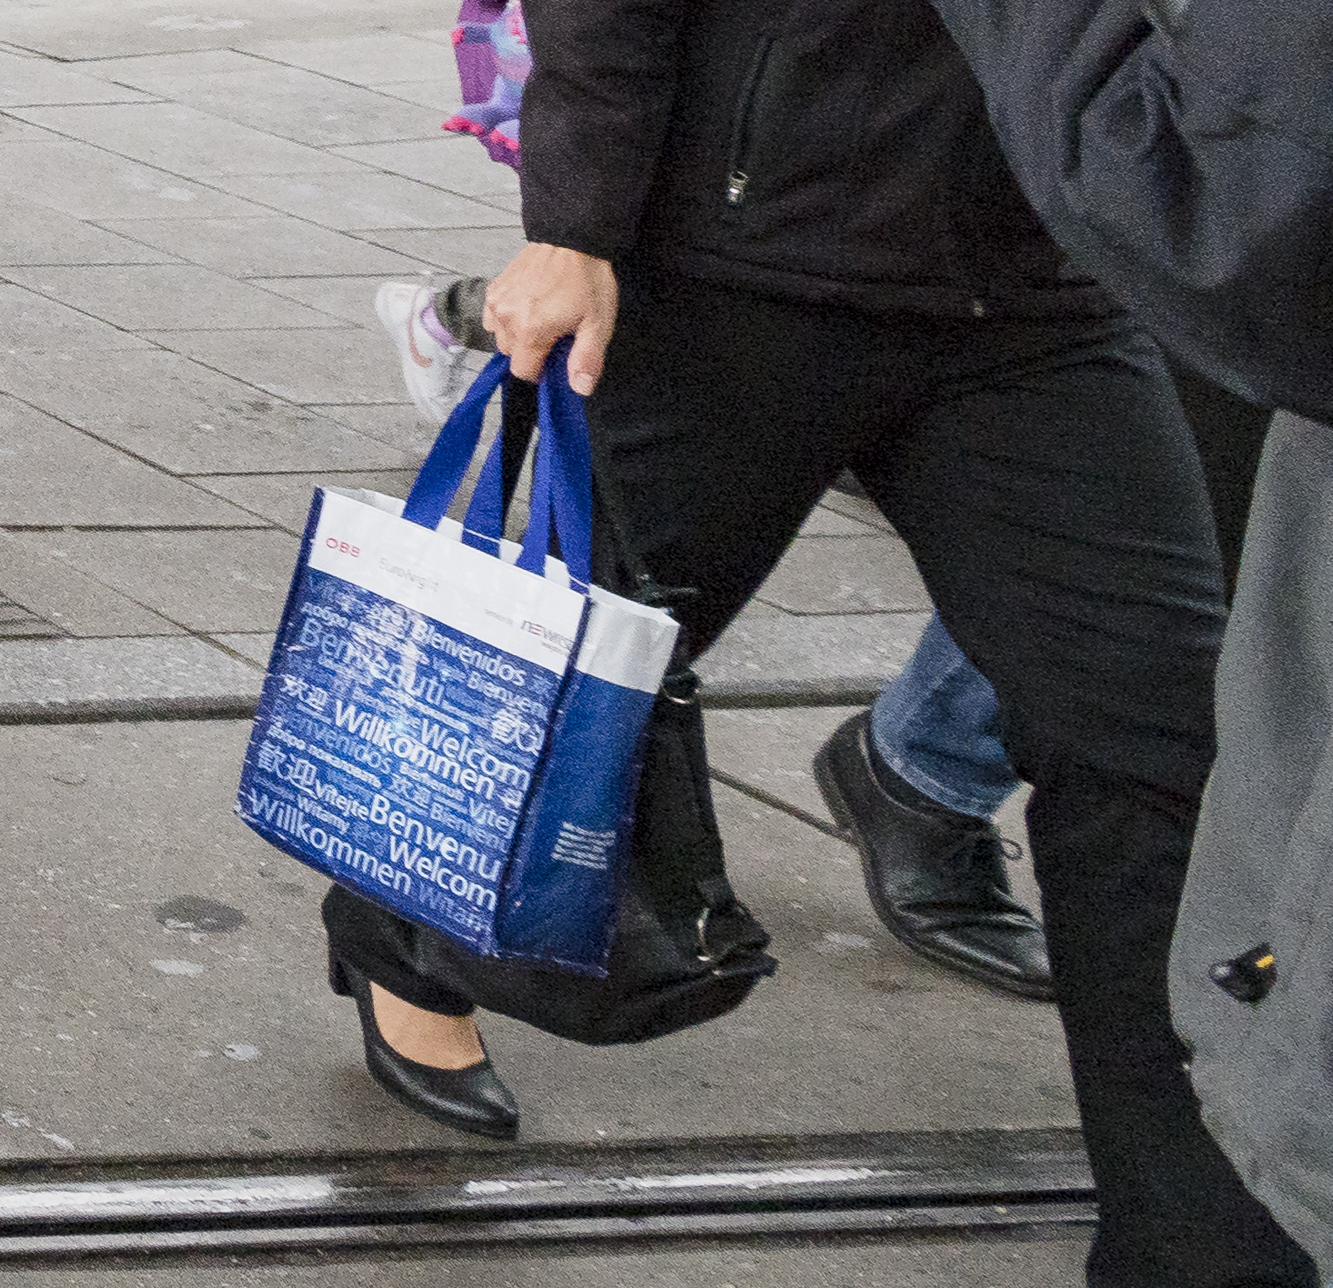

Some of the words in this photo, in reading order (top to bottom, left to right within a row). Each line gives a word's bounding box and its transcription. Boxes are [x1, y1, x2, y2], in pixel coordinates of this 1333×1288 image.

[411, 617, 527, 687] Bienvenidos
[335, 698, 496, 801] Willkommen
[251, 787, 412, 895] Willkommen
